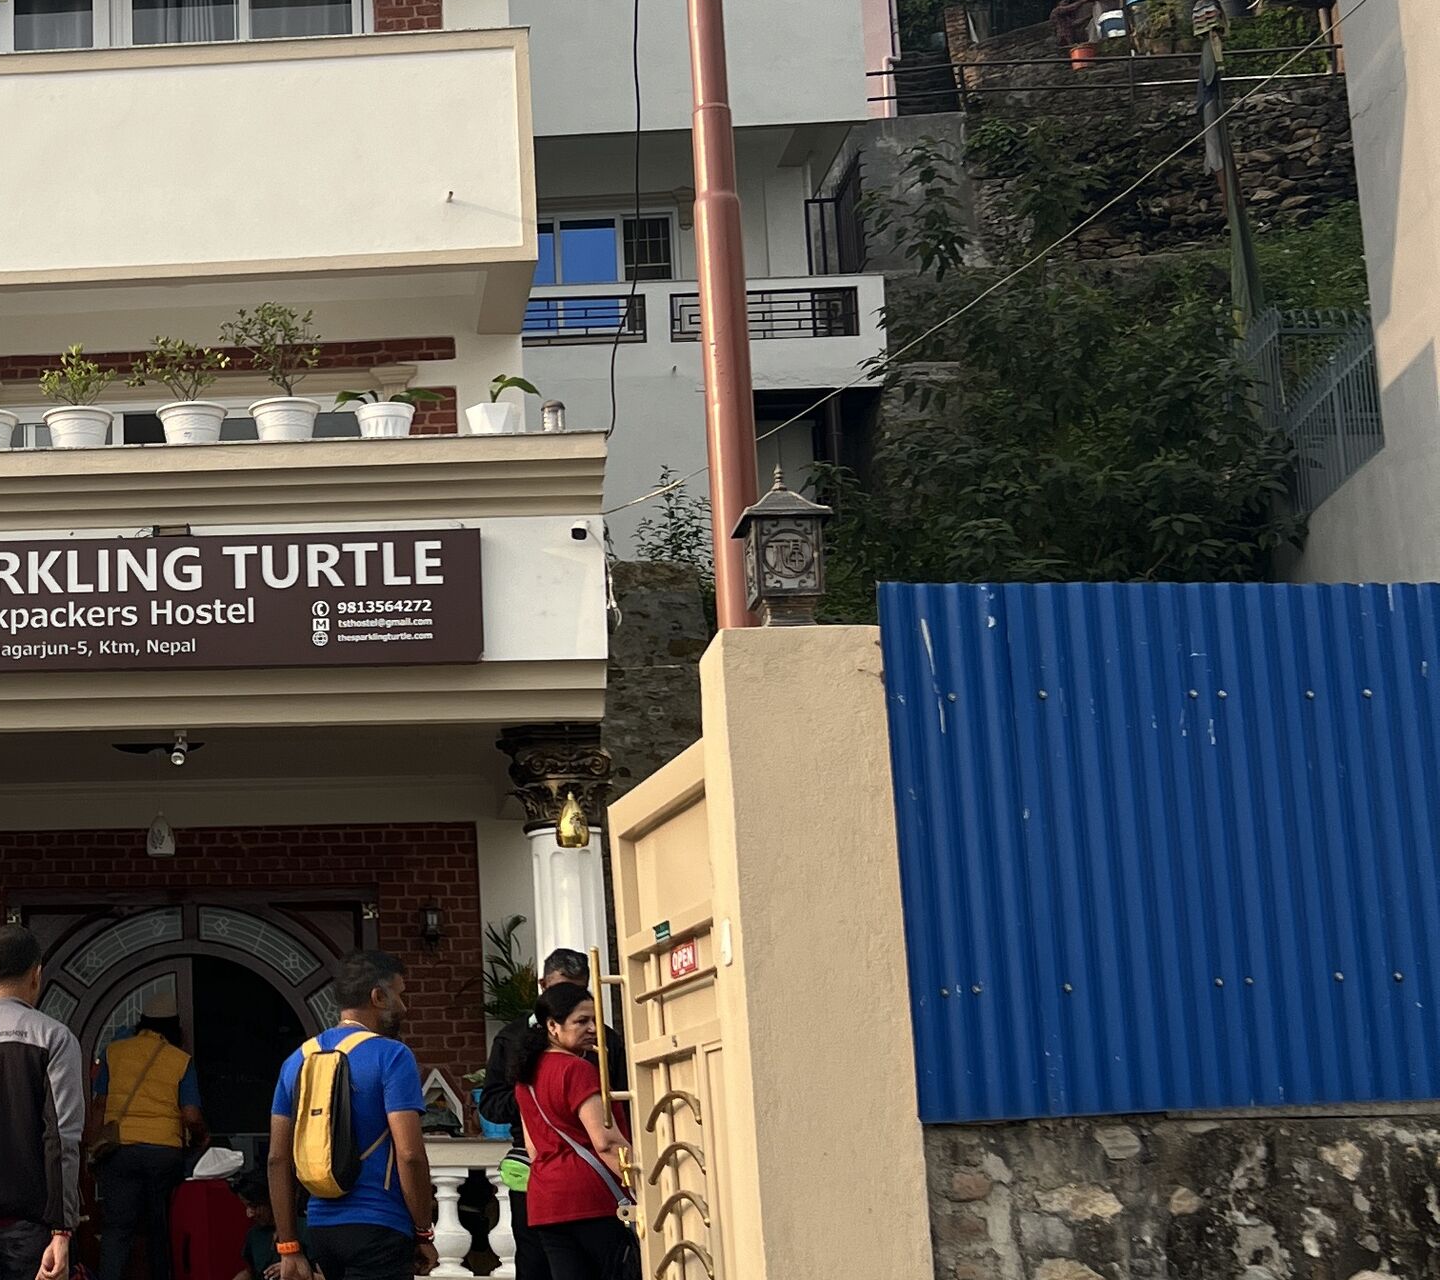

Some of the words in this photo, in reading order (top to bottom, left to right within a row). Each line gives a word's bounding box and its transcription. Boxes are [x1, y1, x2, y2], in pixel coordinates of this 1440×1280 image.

[222, 540, 444, 589] TURTLE
[150, 596, 255, 625] Hostel
[337, 599, 433, 614] 9813564272
[337, 617, 433, 629] tsthostel@gmail.com
[337, 631, 434, 643] thesparklingturtle.com
[99, 640, 140, 656] Ktm,
[146, 638, 196, 656] Nepal
[671, 945, 694, 971] OPEN
